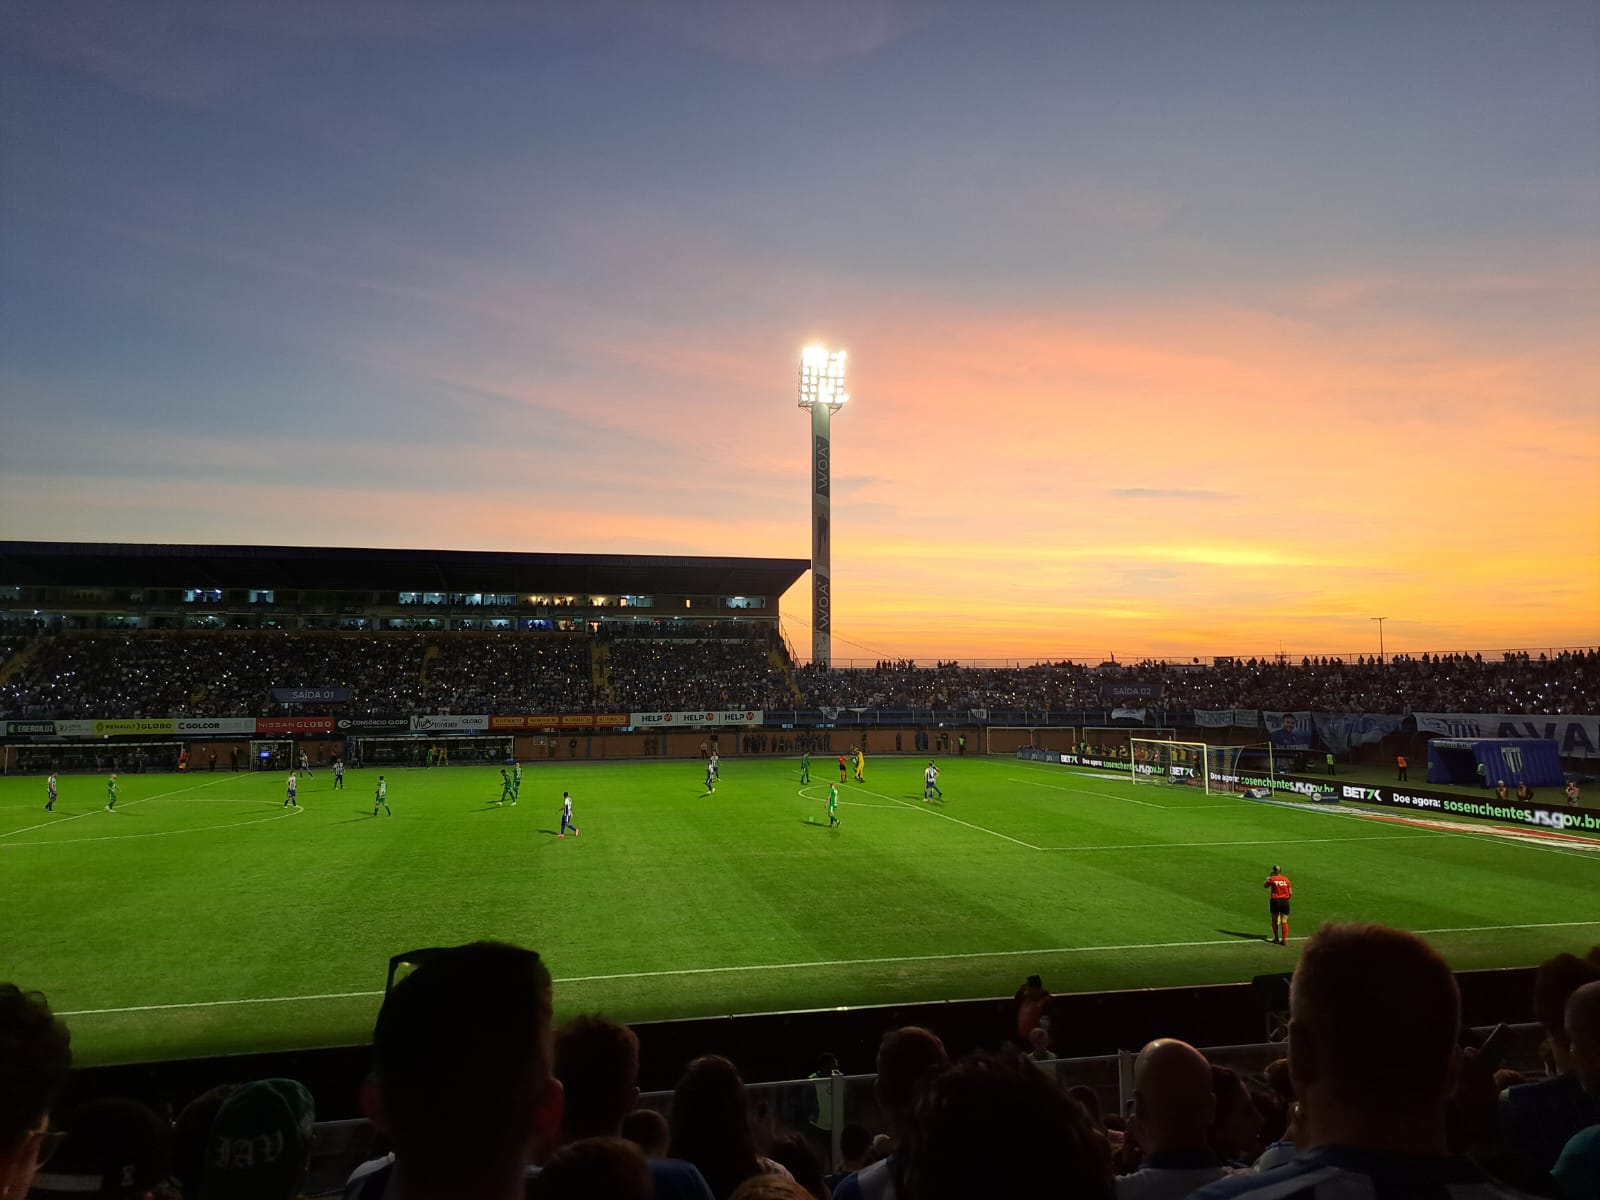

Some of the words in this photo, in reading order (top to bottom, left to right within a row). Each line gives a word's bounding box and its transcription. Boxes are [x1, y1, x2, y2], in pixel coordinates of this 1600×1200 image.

[818, 446, 829, 489] WOA
[818, 582, 829, 629] WOA
[291, 689, 320, 699] SAÍDA
[323, 690, 334, 699] 01
[1113, 686, 1139, 696] SAÍDA
[1140, 687, 1151, 696] 02
[724, 713, 744, 721] HELP
[296, 720, 332, 728] GLOBO
[1499, 722, 1600, 753] AVA
[1392, 793, 1411, 804] Doe
[1412, 795, 1441, 809] agora:
